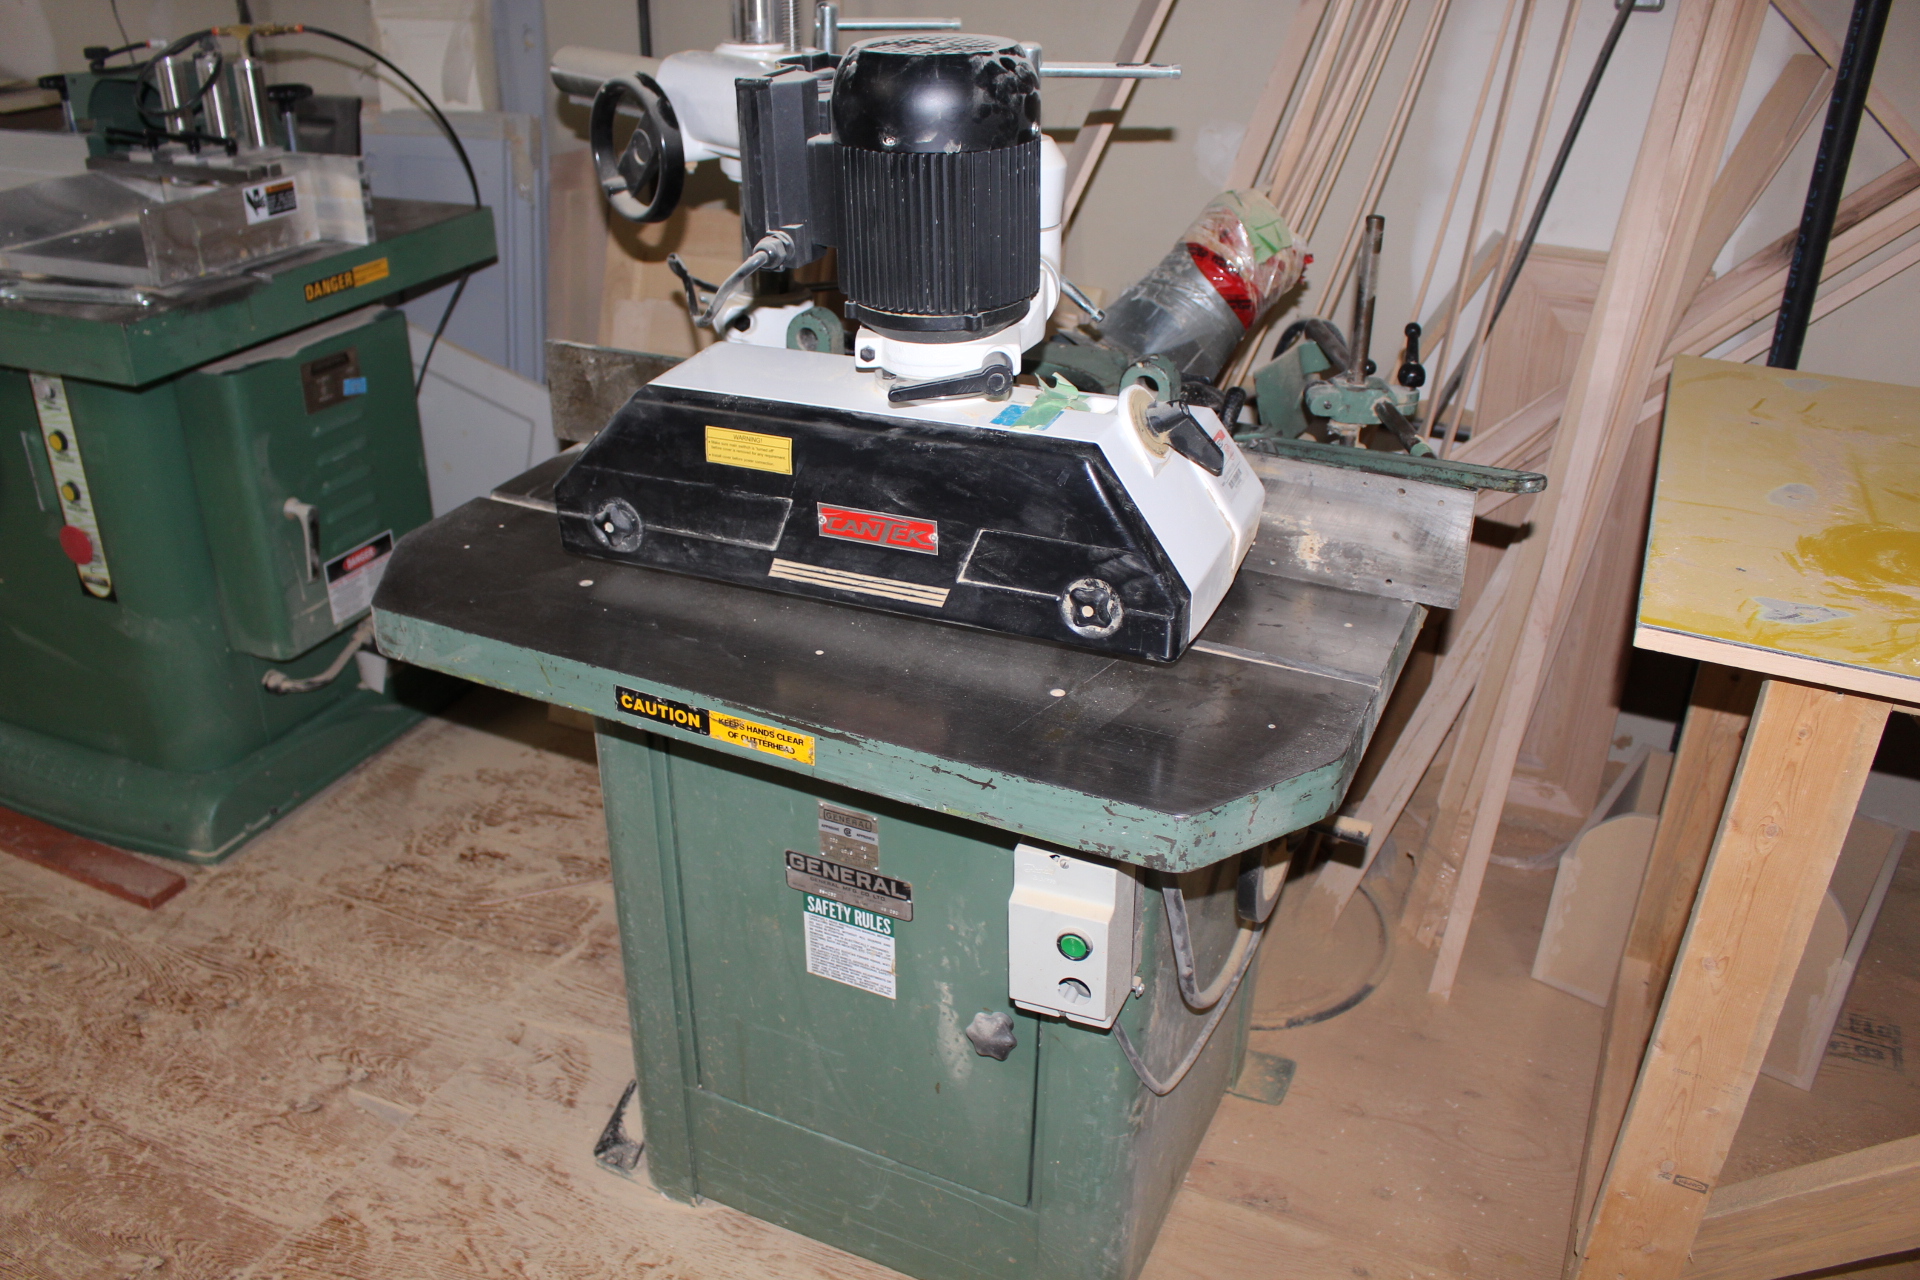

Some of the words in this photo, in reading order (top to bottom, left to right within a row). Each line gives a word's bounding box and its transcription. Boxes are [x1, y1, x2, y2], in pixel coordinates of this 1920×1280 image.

[305, 271, 352, 300] DANGER
[733, 434, 762, 444] WARNING!
[825, 517, 932, 545] CANTEK
[620, 694, 701, 728] CAUTION
[718, 716, 745, 731] KEEPS
[746, 724, 775, 739] HANDS
[776, 732, 804, 746] CLEAR
[728, 730, 739, 740] OF
[740, 734, 796, 755] CUTTERHEAD
[826, 812, 870, 830] GENERAL
[788, 853, 908, 900] GENERAL
[807, 896, 852, 922] SAFETY
[854, 910, 891, 934] RULES
